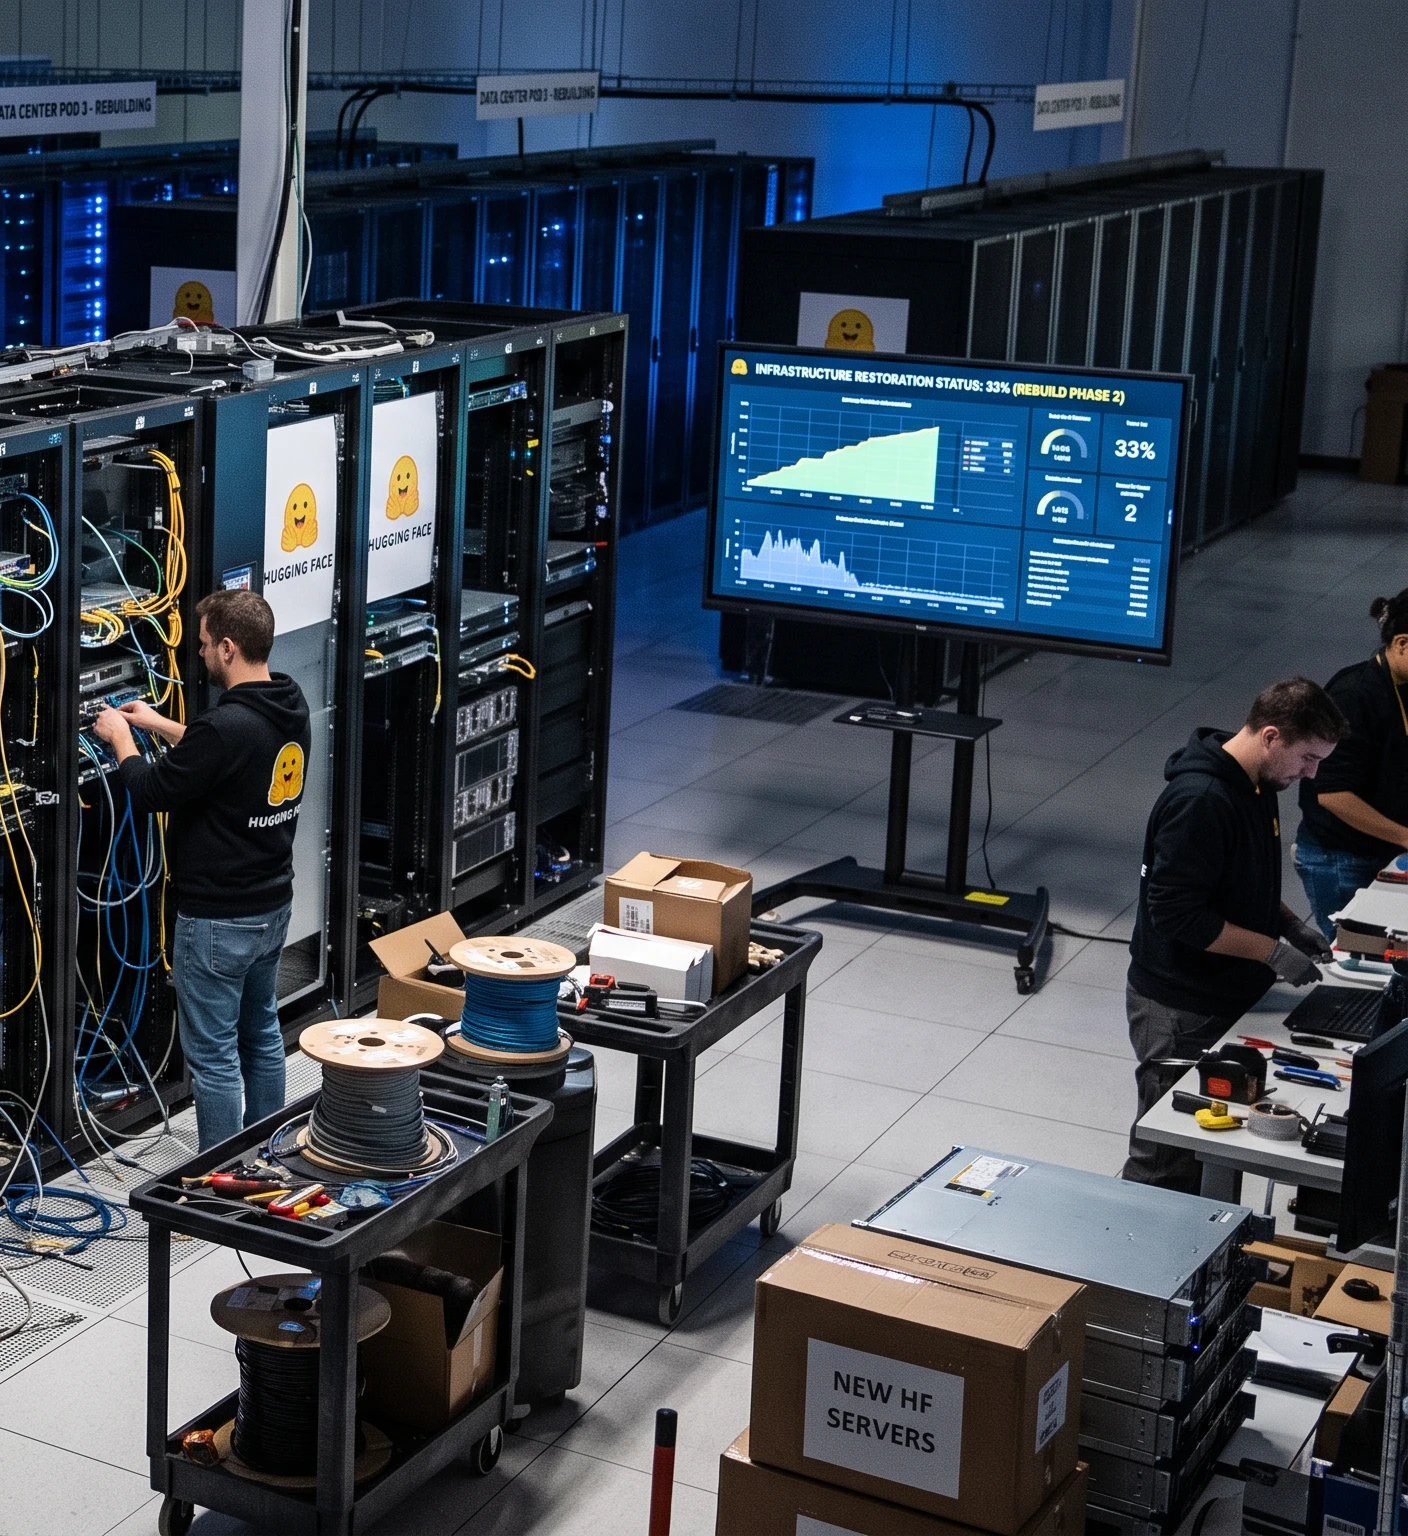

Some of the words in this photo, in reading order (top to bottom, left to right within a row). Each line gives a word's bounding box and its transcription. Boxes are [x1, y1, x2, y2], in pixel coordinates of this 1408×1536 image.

[19, 102, 58, 120] CENTER
[59, 101, 80, 117] POD
[81, 100, 88, 116] 3
[95, 97, 152, 115] REBUILDING
[755, 362, 853, 382] INFRASTRUCTURE
[854, 370, 934, 388] RESTORATION
[935, 377, 984, 392] STATUS:
[985, 380, 1010, 394] 33%
[1012, 382, 1067, 398] (REBUILD
[1069, 387, 1110, 403] PHASE
[1112, 390, 1125, 407] 2)
[1114, 439, 1156, 460] 33%
[1124, 503, 1137, 522] 2
[369, 529, 409, 552] HUGGING
[411, 522, 433, 540] FACE
[264, 560, 308, 586] HUGGING
[310, 553, 333, 573] FACE
[833, 1370, 892, 1404] NEW
[900, 1388, 933, 1414] HF
[826, 1407, 936, 1453] SERVERS
